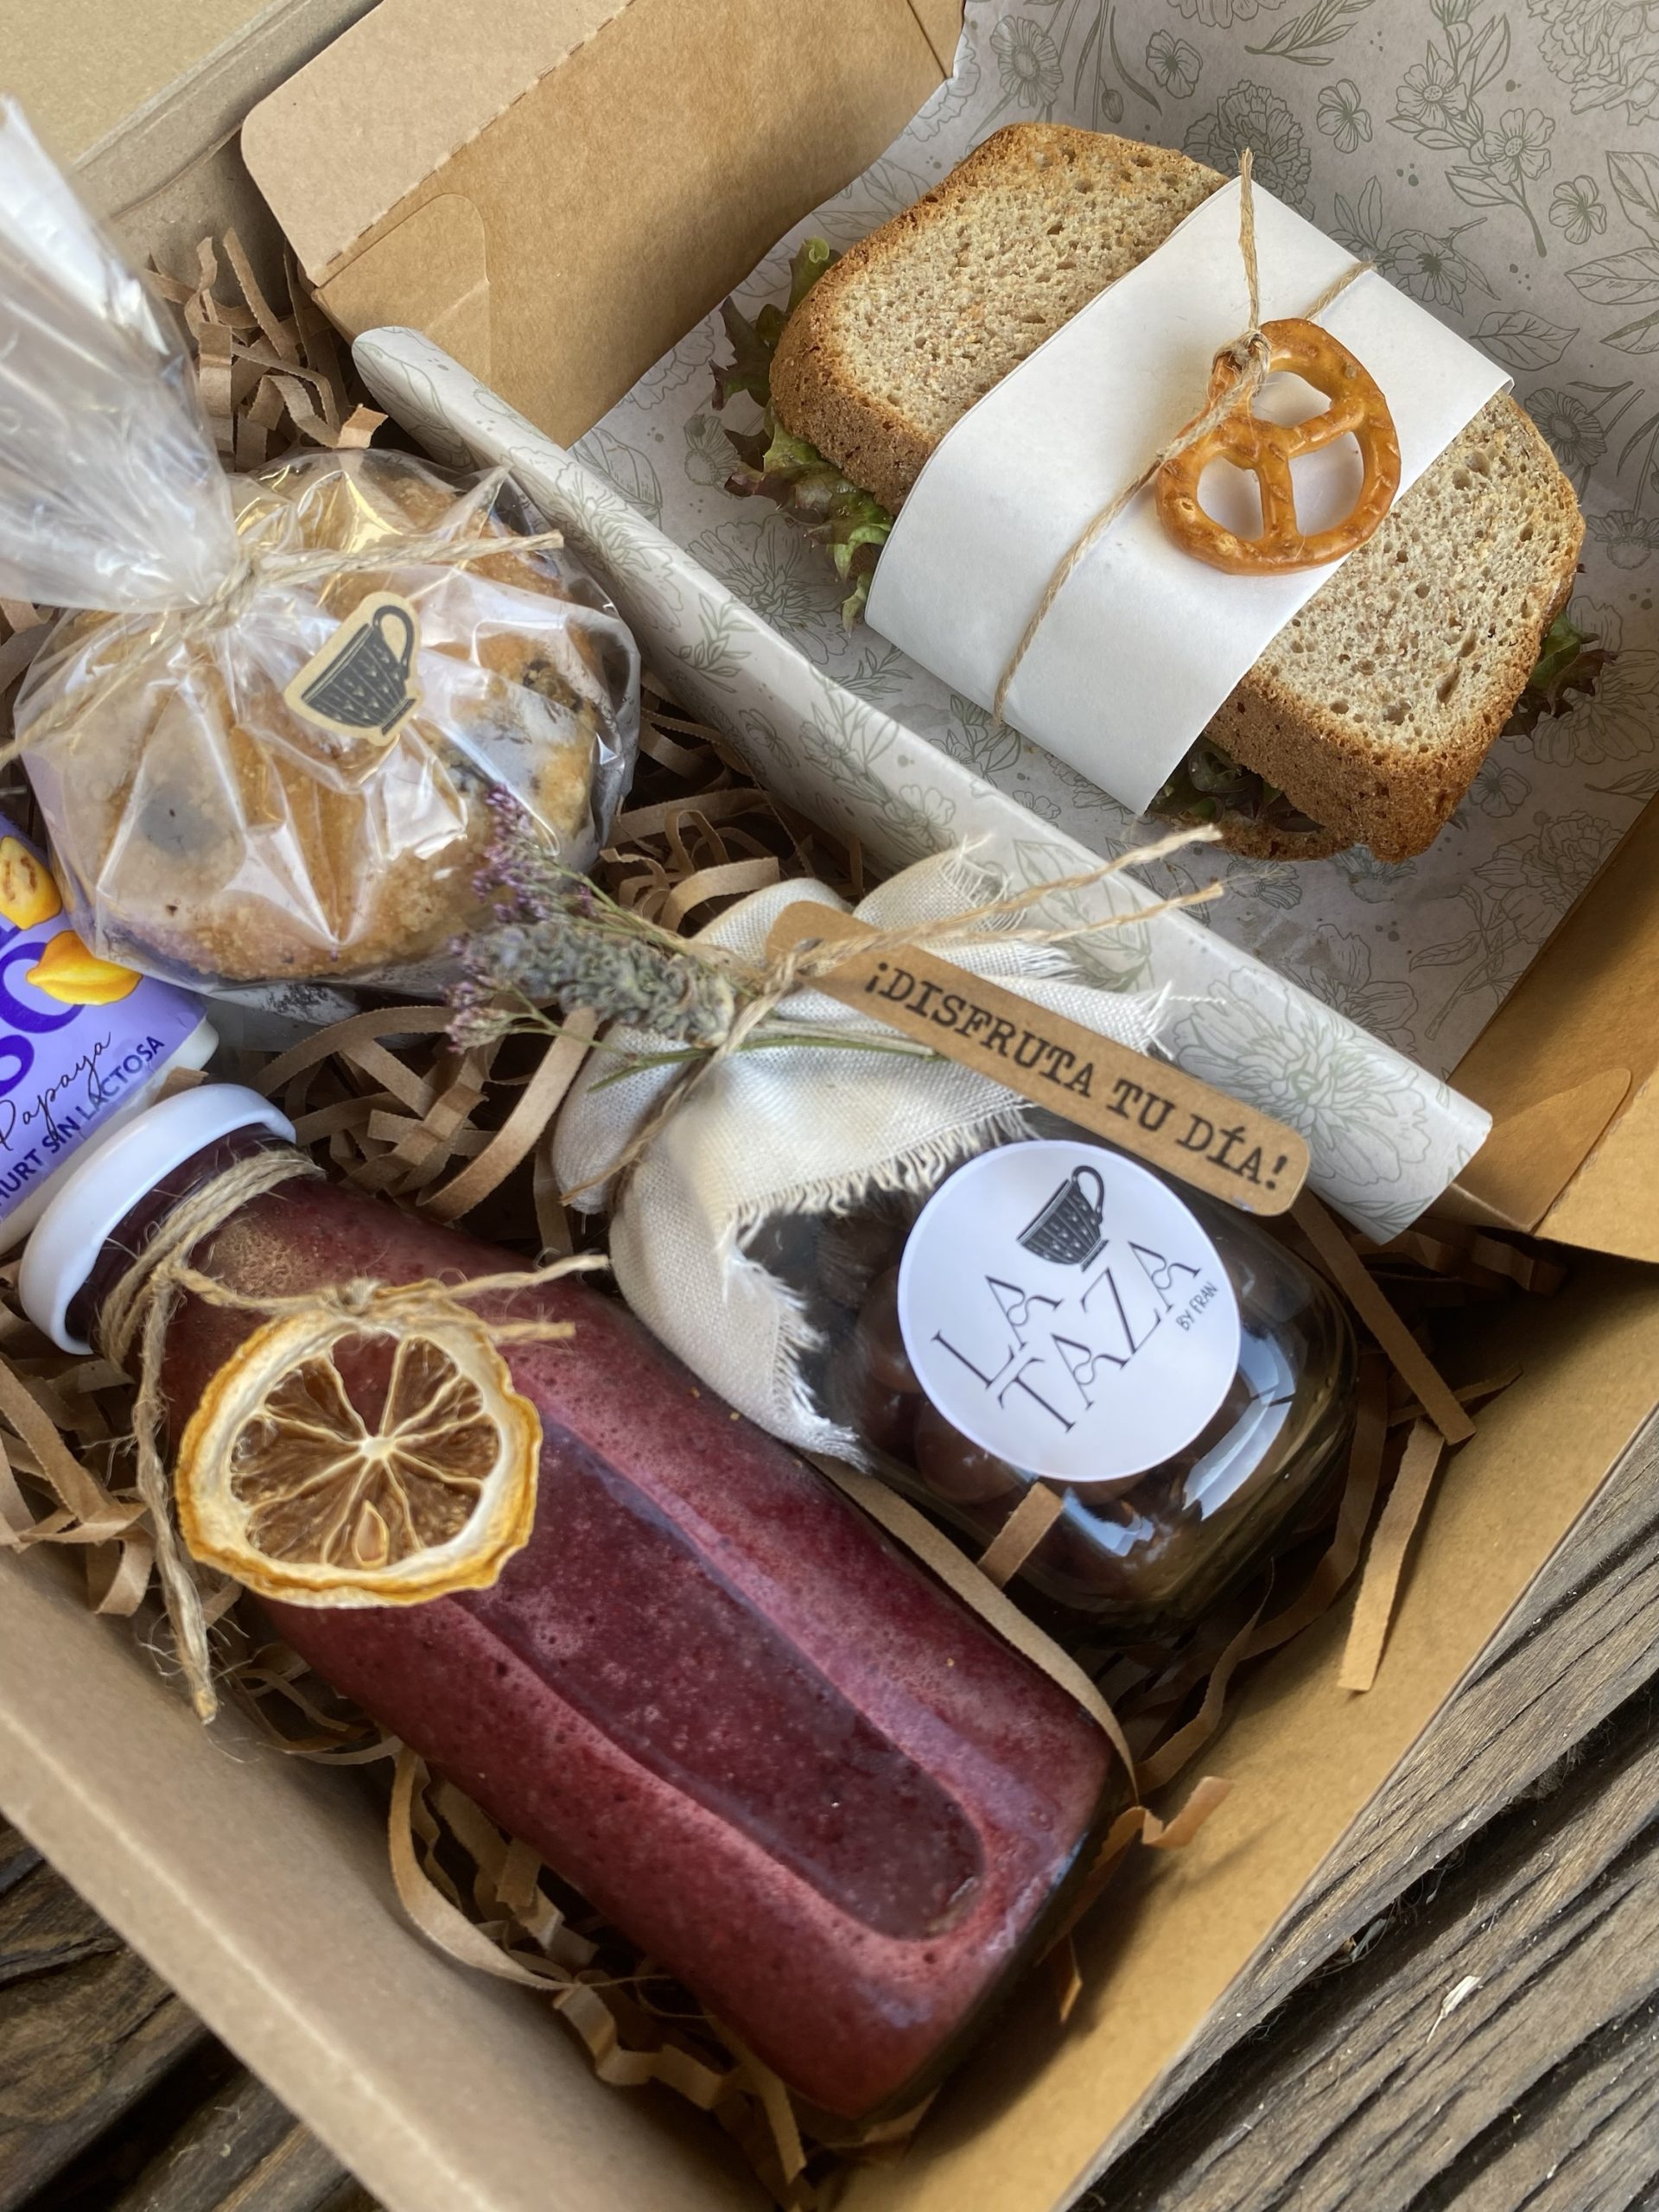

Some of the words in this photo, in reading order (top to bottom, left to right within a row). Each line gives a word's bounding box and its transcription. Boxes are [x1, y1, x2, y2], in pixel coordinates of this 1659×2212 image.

[0, 1032, 111, 1151] Papaya
[41, 1116, 81, 1154] SIN
[75, 1036, 165, 1121] LACTOSA
[865, 963, 1094, 1098] ¡DISFRUTA
[1107, 1077, 1178, 1133] TU
[1176, 1114, 1289, 1192] DÍA!
[931, 1274, 1064, 1390] LA
[997, 1241, 1201, 1433] TAZA
[1175, 1308, 1194, 1332] BY
